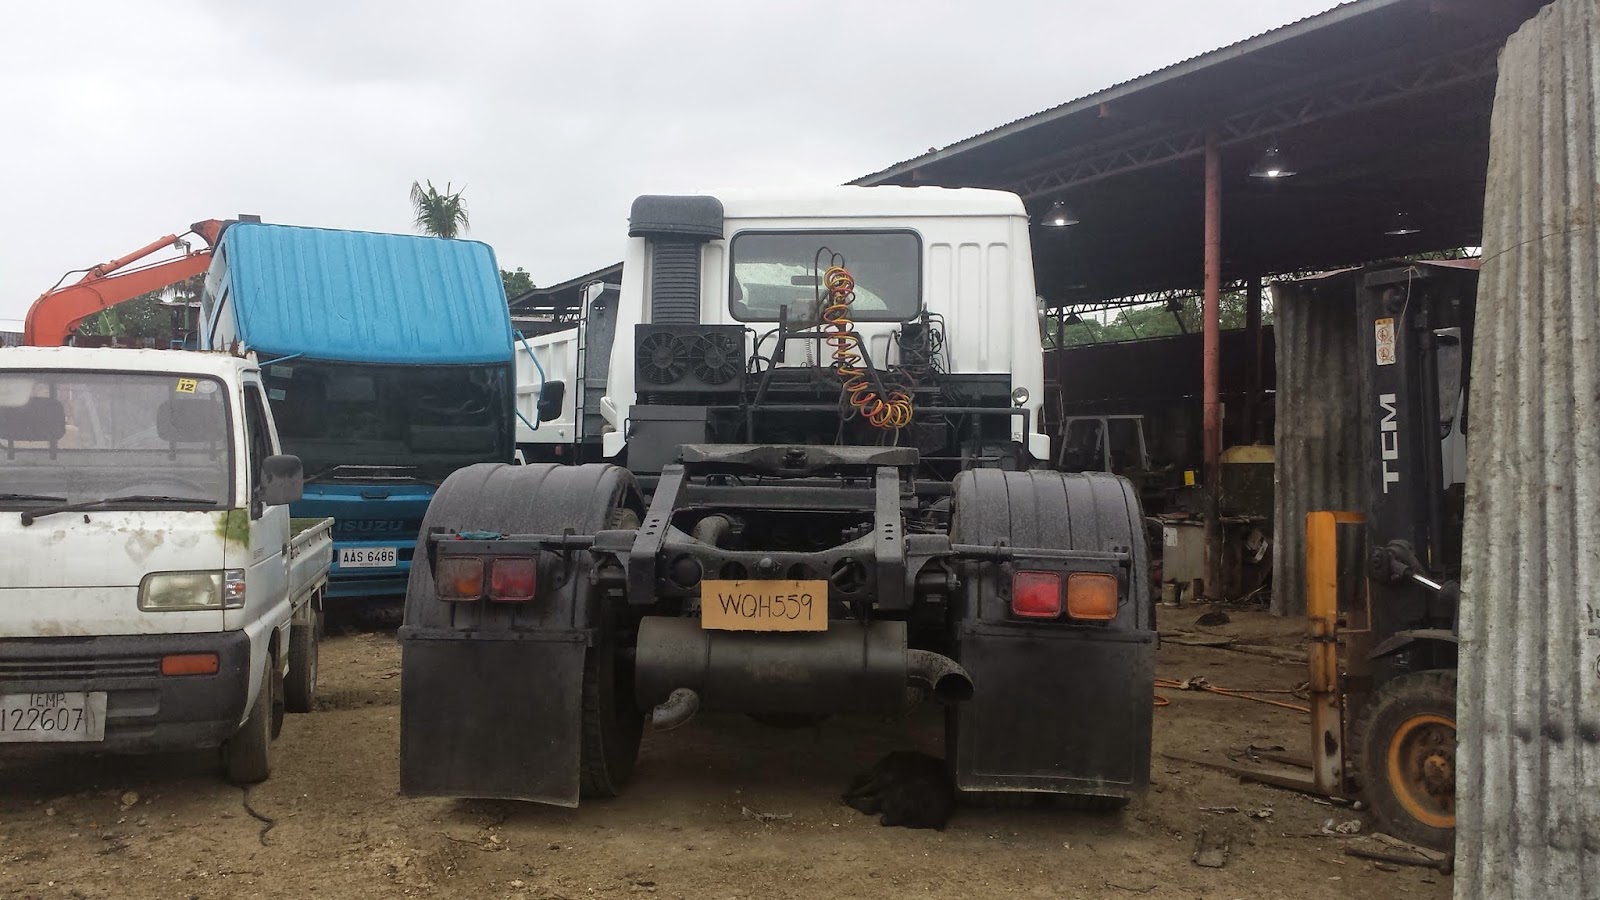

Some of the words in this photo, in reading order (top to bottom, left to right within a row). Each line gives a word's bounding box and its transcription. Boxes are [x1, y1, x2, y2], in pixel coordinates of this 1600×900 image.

[180, 383, 194, 391] 12
[1380, 393, 1399, 494] TCM
[337, 519, 404, 532] ISUZU
[343, 551, 363, 563] AAS
[367, 551, 394, 562] 6486
[718, 593, 813, 621] WQH559
